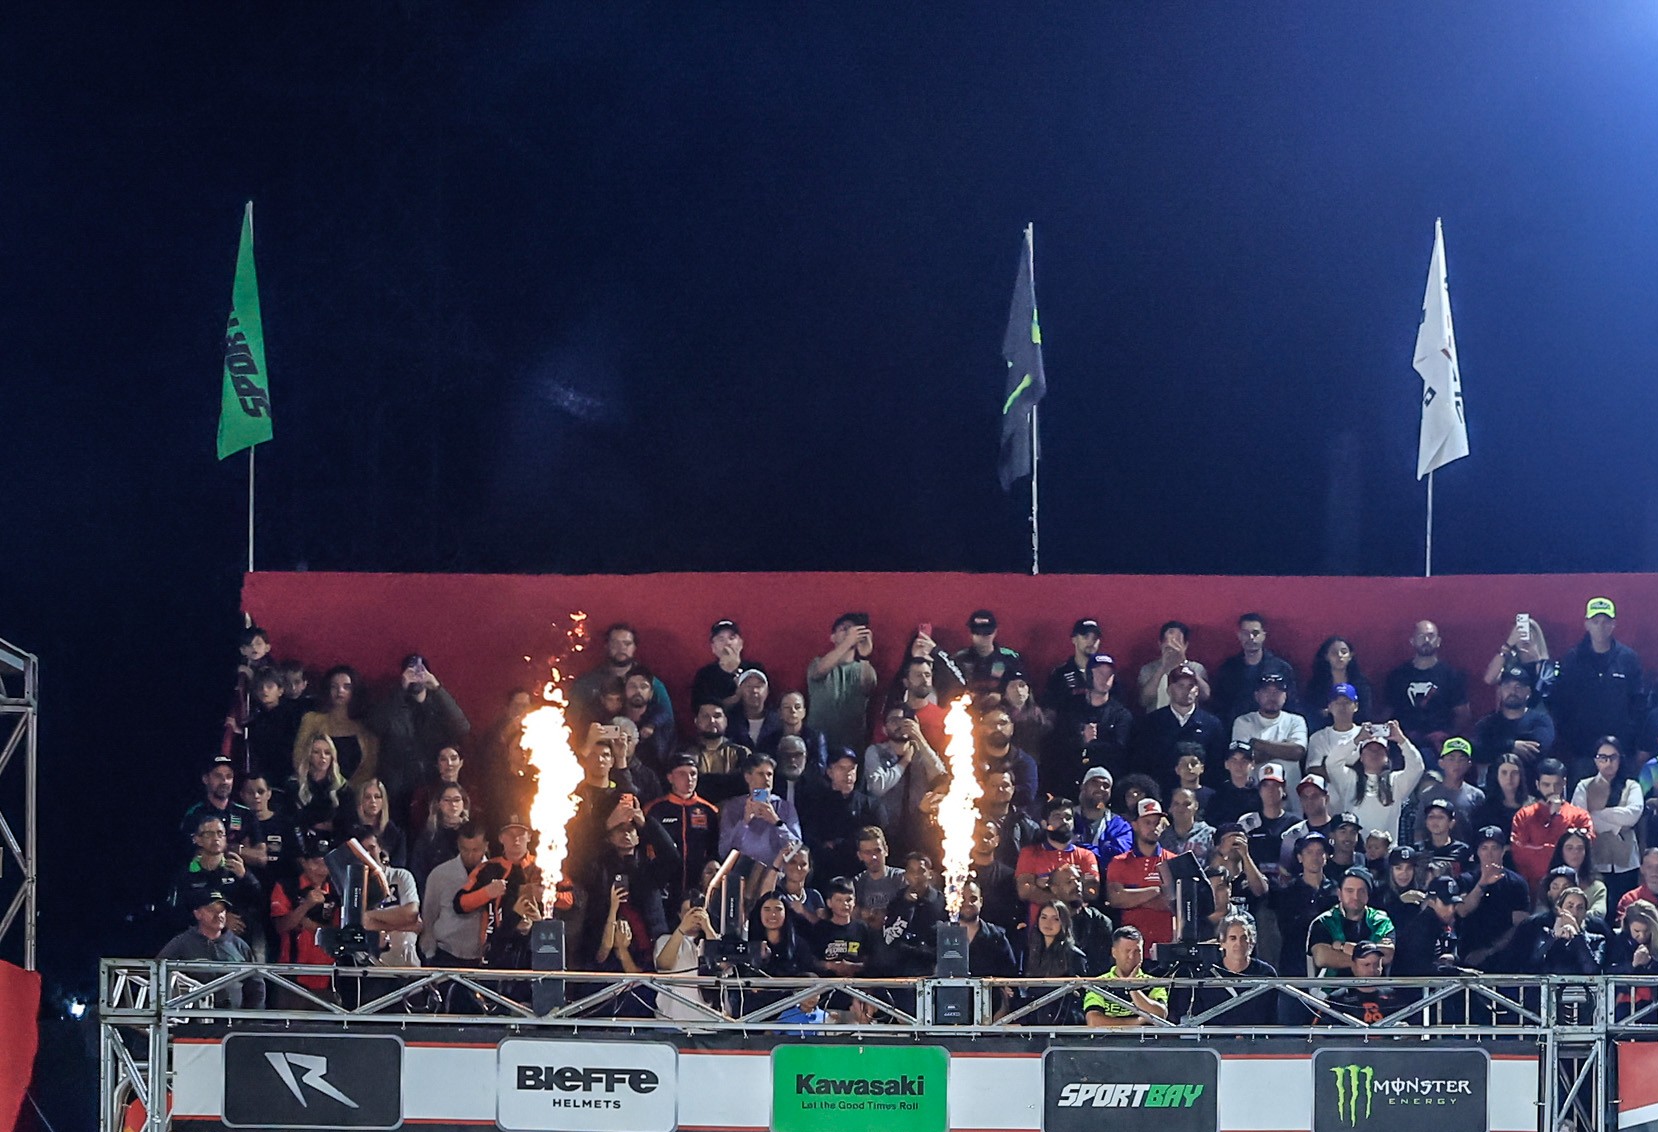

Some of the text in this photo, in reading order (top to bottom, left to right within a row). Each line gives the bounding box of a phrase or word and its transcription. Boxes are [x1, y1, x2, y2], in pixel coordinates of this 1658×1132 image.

[796, 1073, 924, 1096] Kawasaki
[1373, 1076, 1471, 1097] MONSTER
[552, 1098, 622, 1109] HELMETS
[1058, 1083, 1204, 1108] SPORTBAY
[1388, 1098, 1457, 1106] ENERGY
[801, 1100, 919, 1110] Let the Good Times Roll
